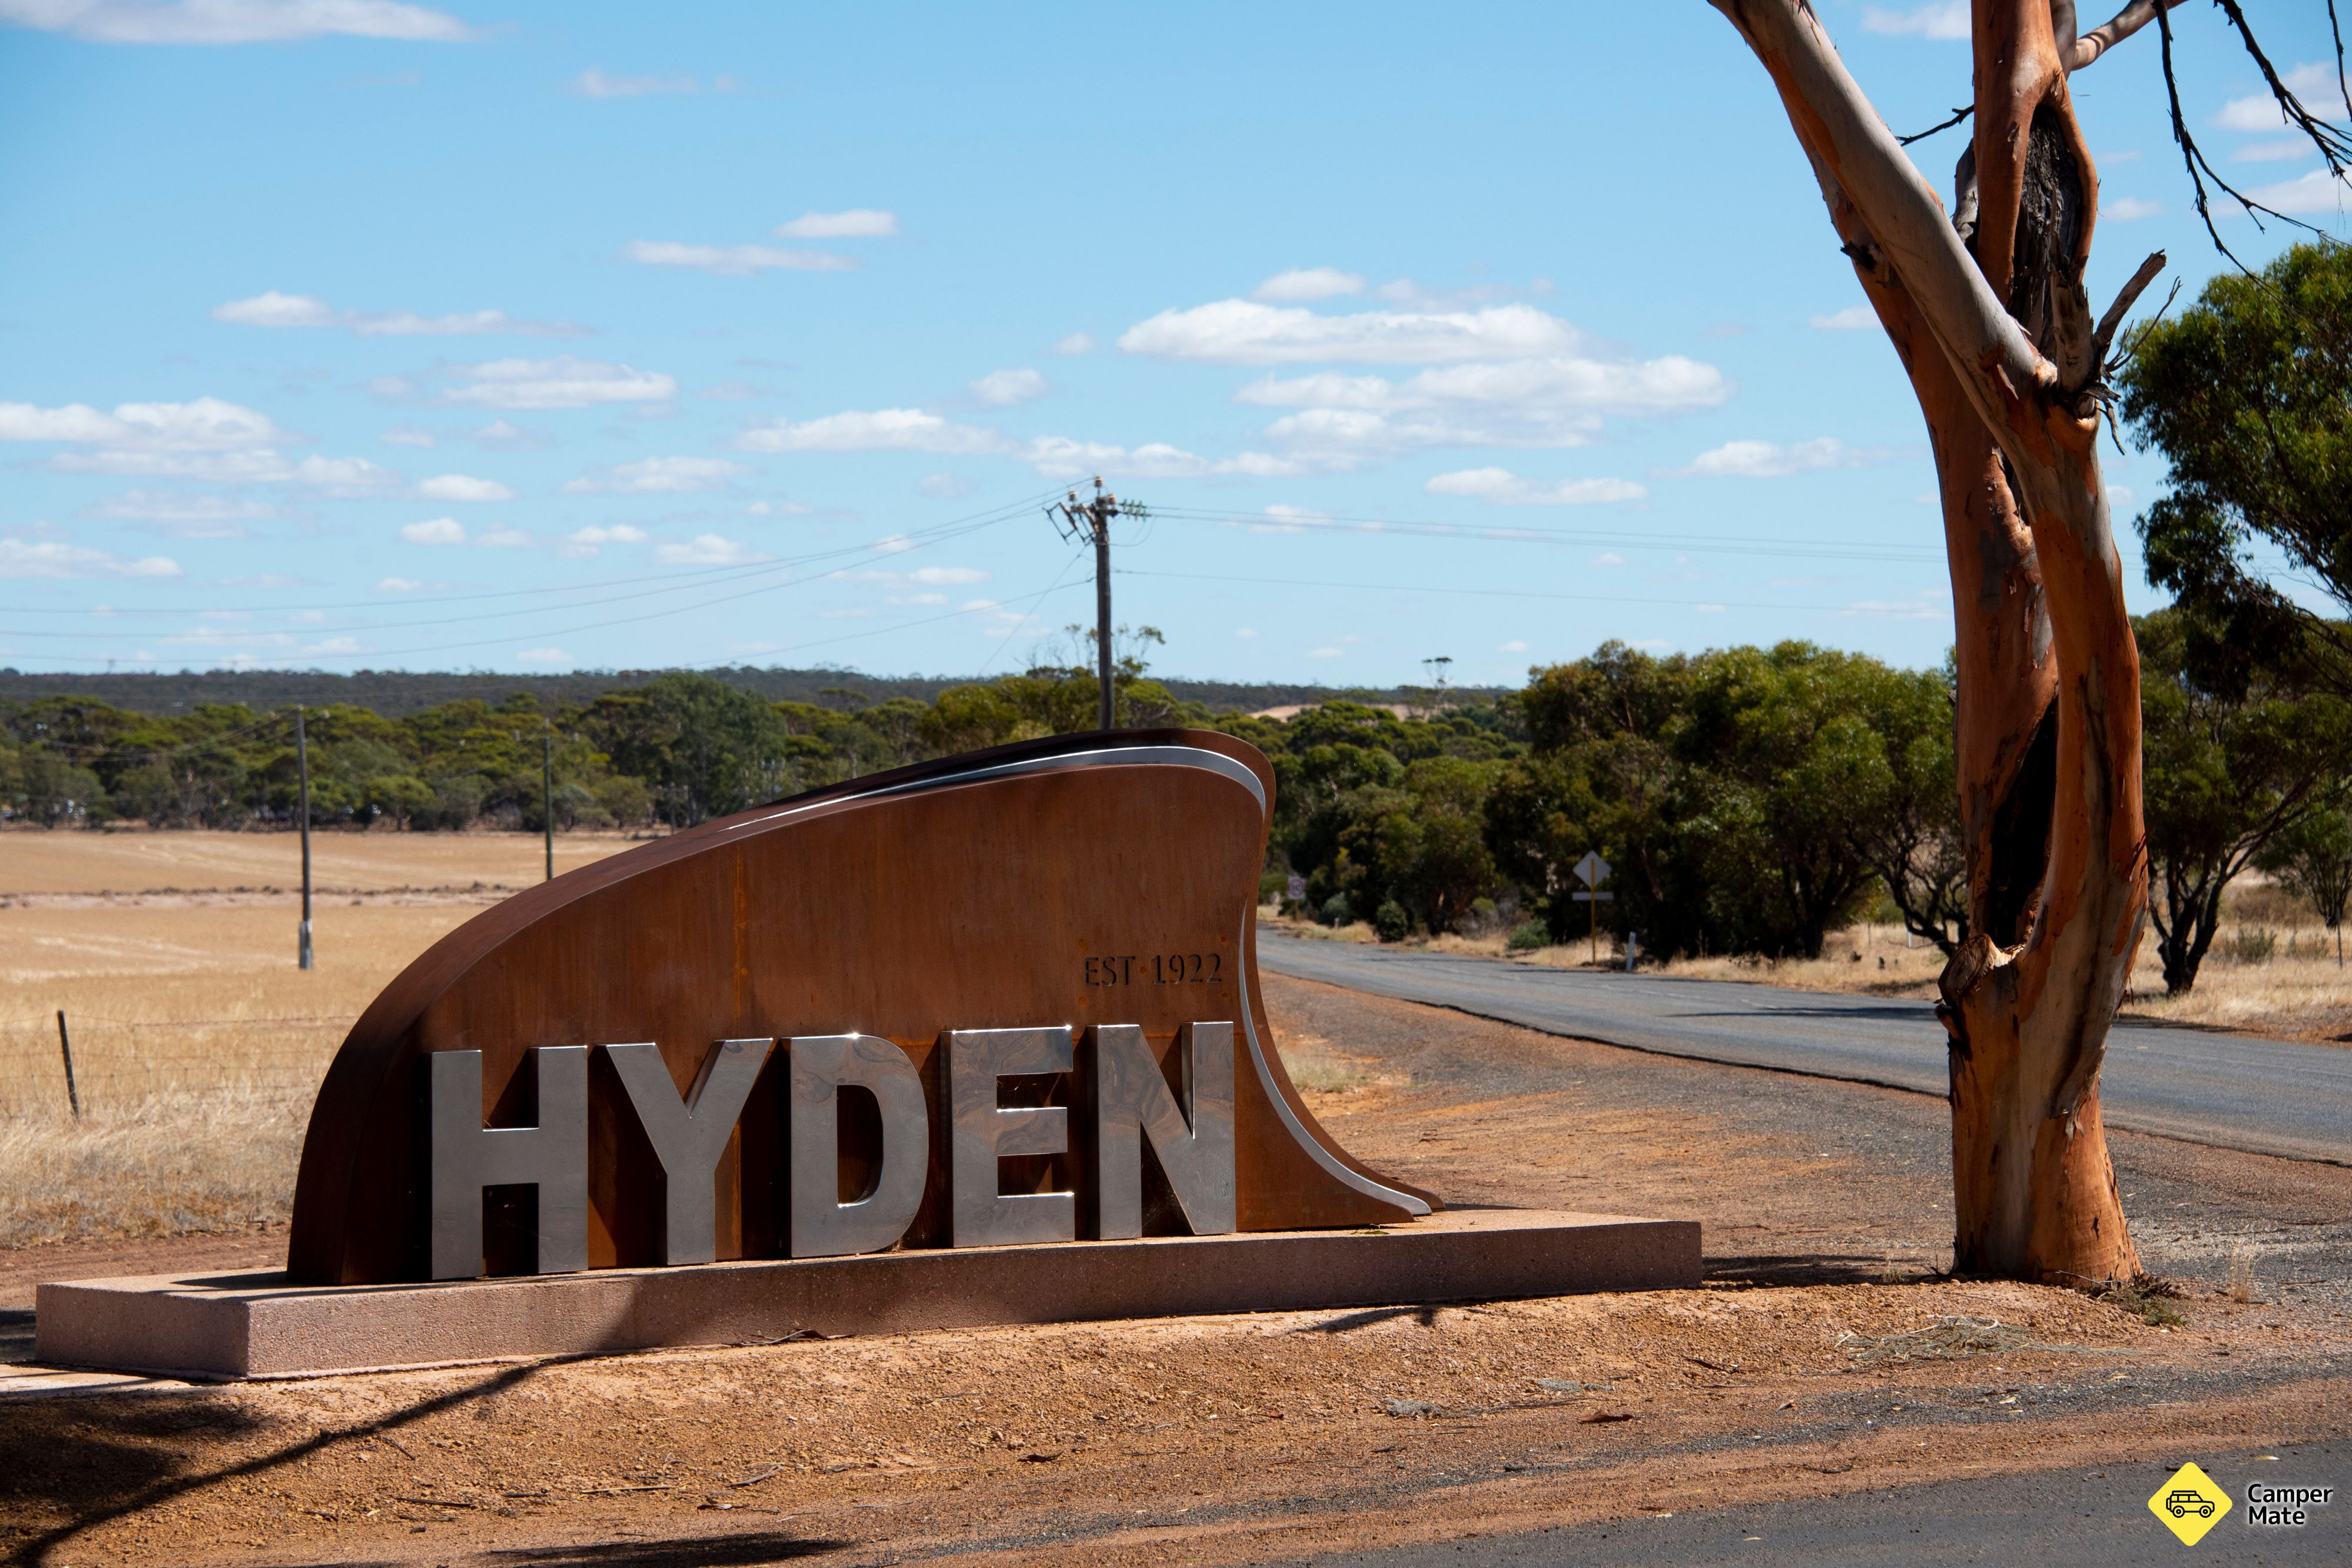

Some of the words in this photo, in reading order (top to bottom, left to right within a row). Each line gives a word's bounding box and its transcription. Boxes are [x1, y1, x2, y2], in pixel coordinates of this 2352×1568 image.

[1084, 955, 1136, 987] EST
[1150, 952, 1223, 985] 1922
[431, 1021, 1237, 1280] HYDEN
